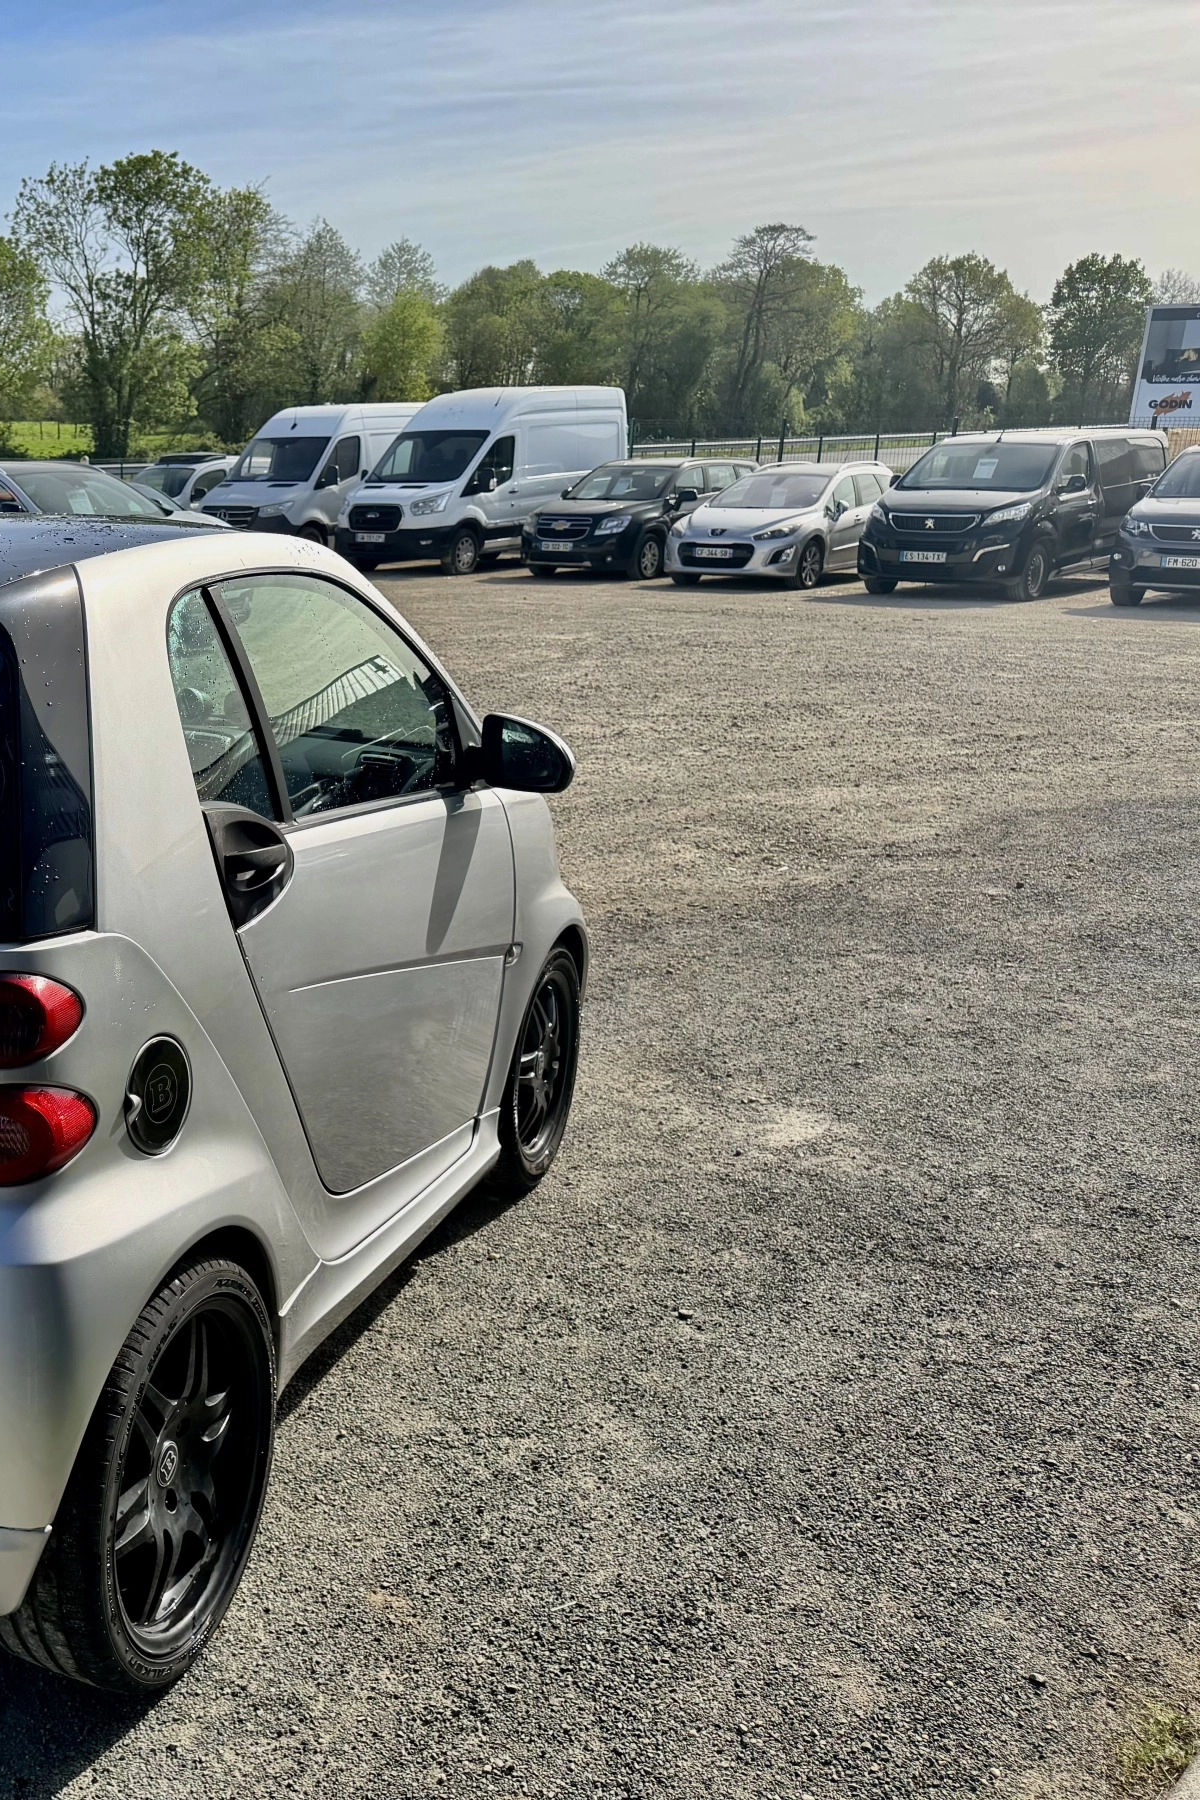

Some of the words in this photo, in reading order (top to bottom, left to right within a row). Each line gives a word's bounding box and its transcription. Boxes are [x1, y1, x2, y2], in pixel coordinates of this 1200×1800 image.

[1148, 399, 1193, 409] GODIN
[150, 1075, 172, 1113] B
[160, 1450, 177, 1481] B
